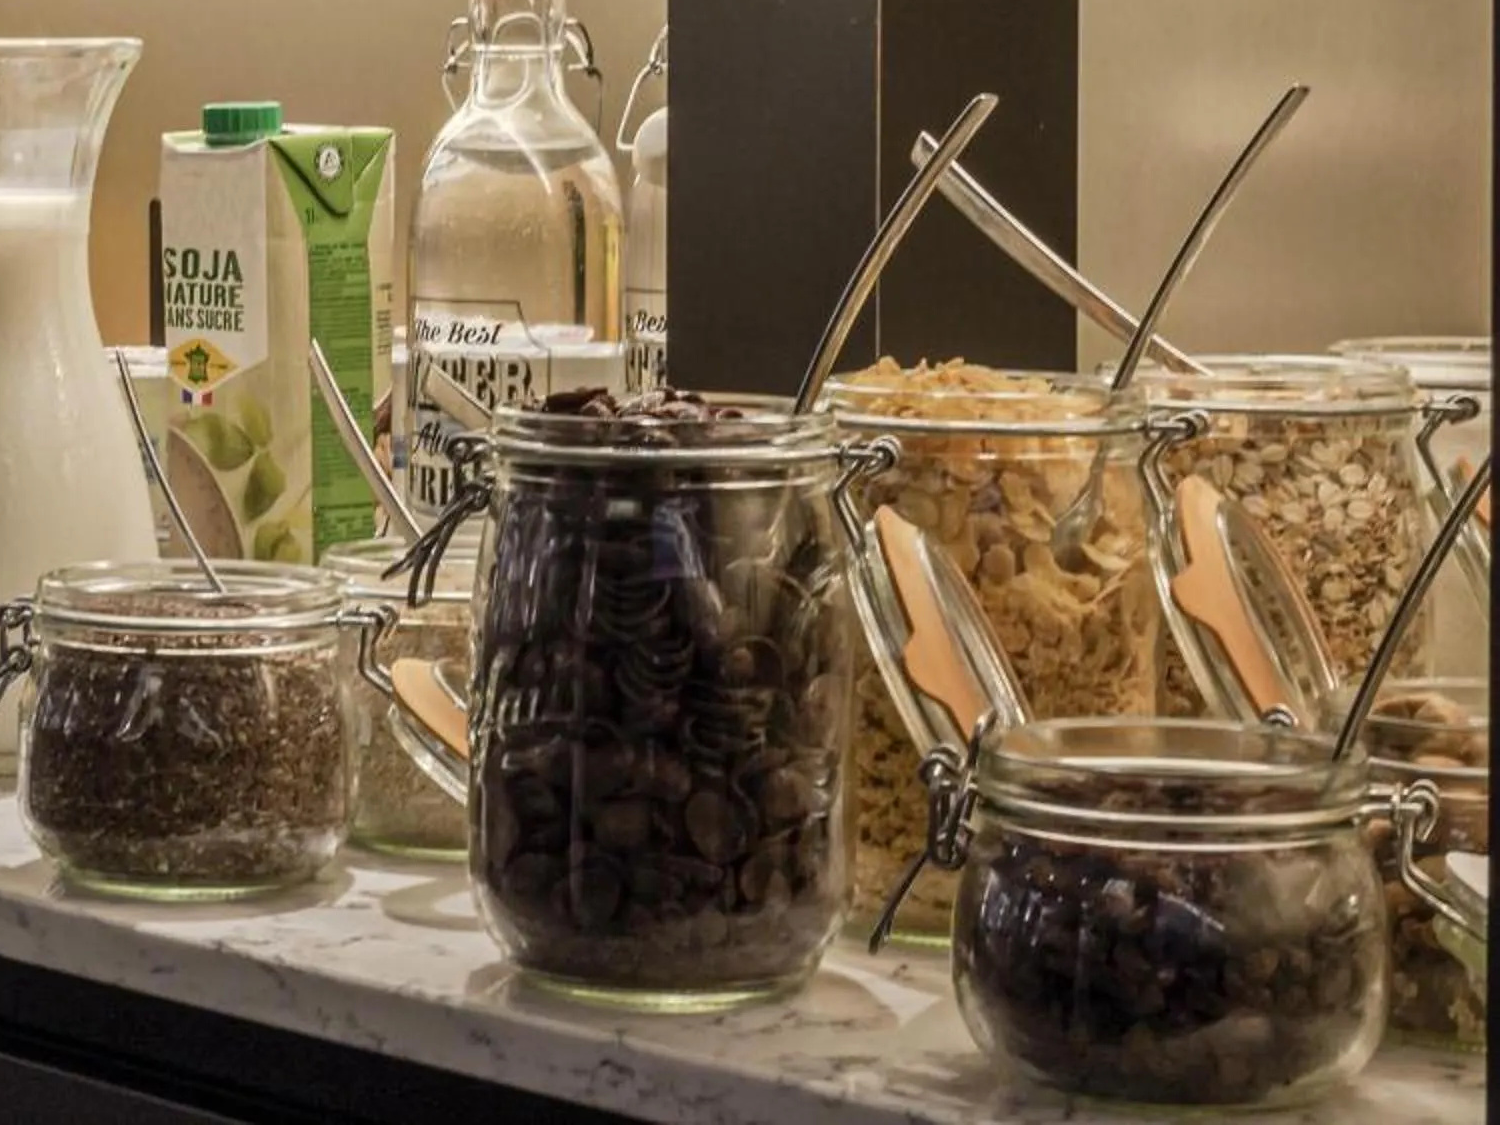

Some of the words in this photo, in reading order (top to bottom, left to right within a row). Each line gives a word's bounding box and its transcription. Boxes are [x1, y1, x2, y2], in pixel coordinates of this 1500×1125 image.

[163, 247, 244, 282] SOJA
[165, 307, 194, 330] ANS
[197, 309, 245, 332] SUCRE
[447, 319, 504, 345] Best
